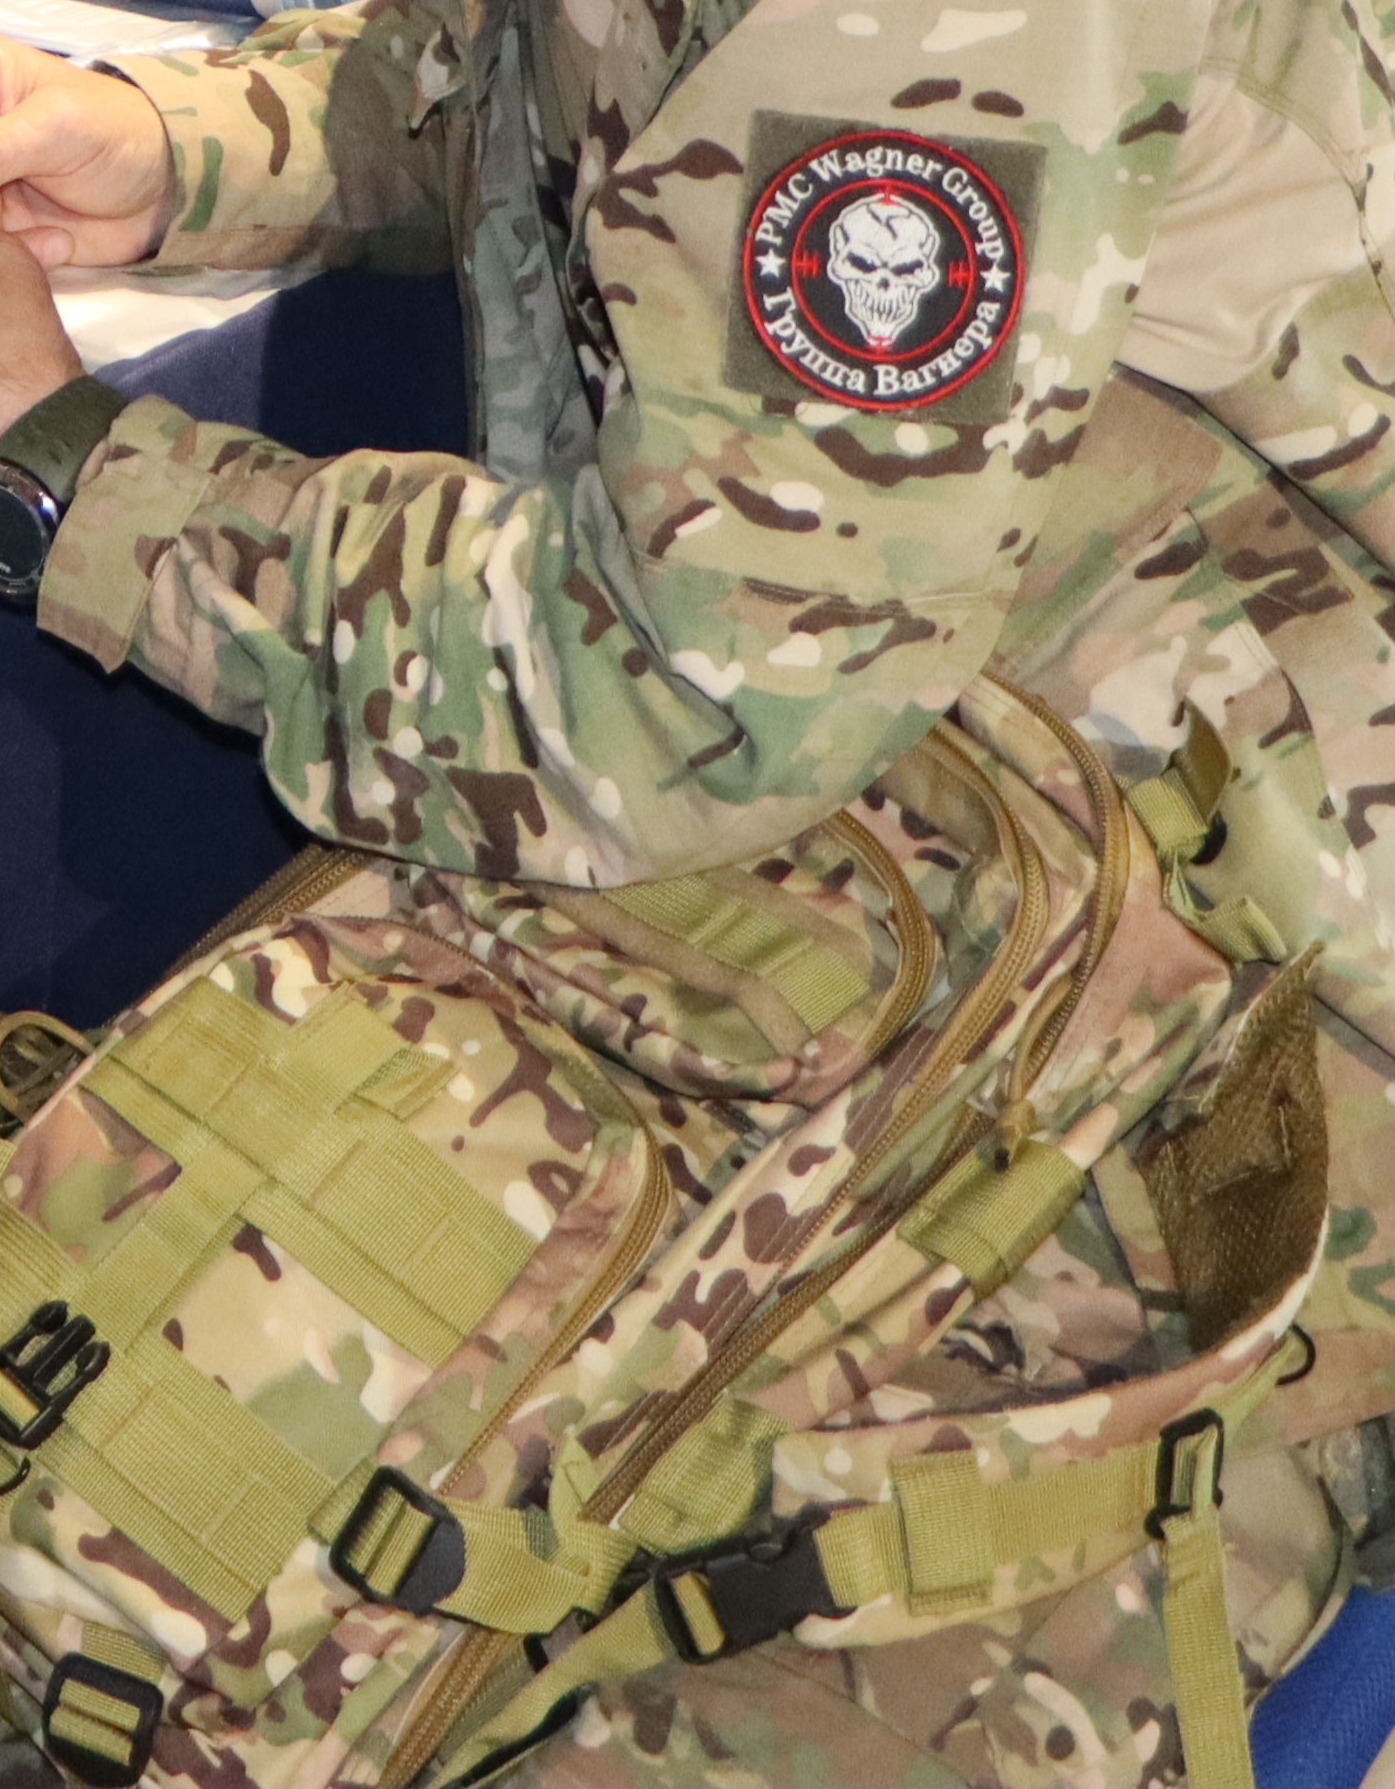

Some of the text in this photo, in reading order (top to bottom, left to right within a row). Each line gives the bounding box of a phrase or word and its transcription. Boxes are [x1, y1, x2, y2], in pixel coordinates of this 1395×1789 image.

[755, 146, 1006, 261] PMC Wagner Group
[762, 286, 1001, 396] Группа Вагнера
